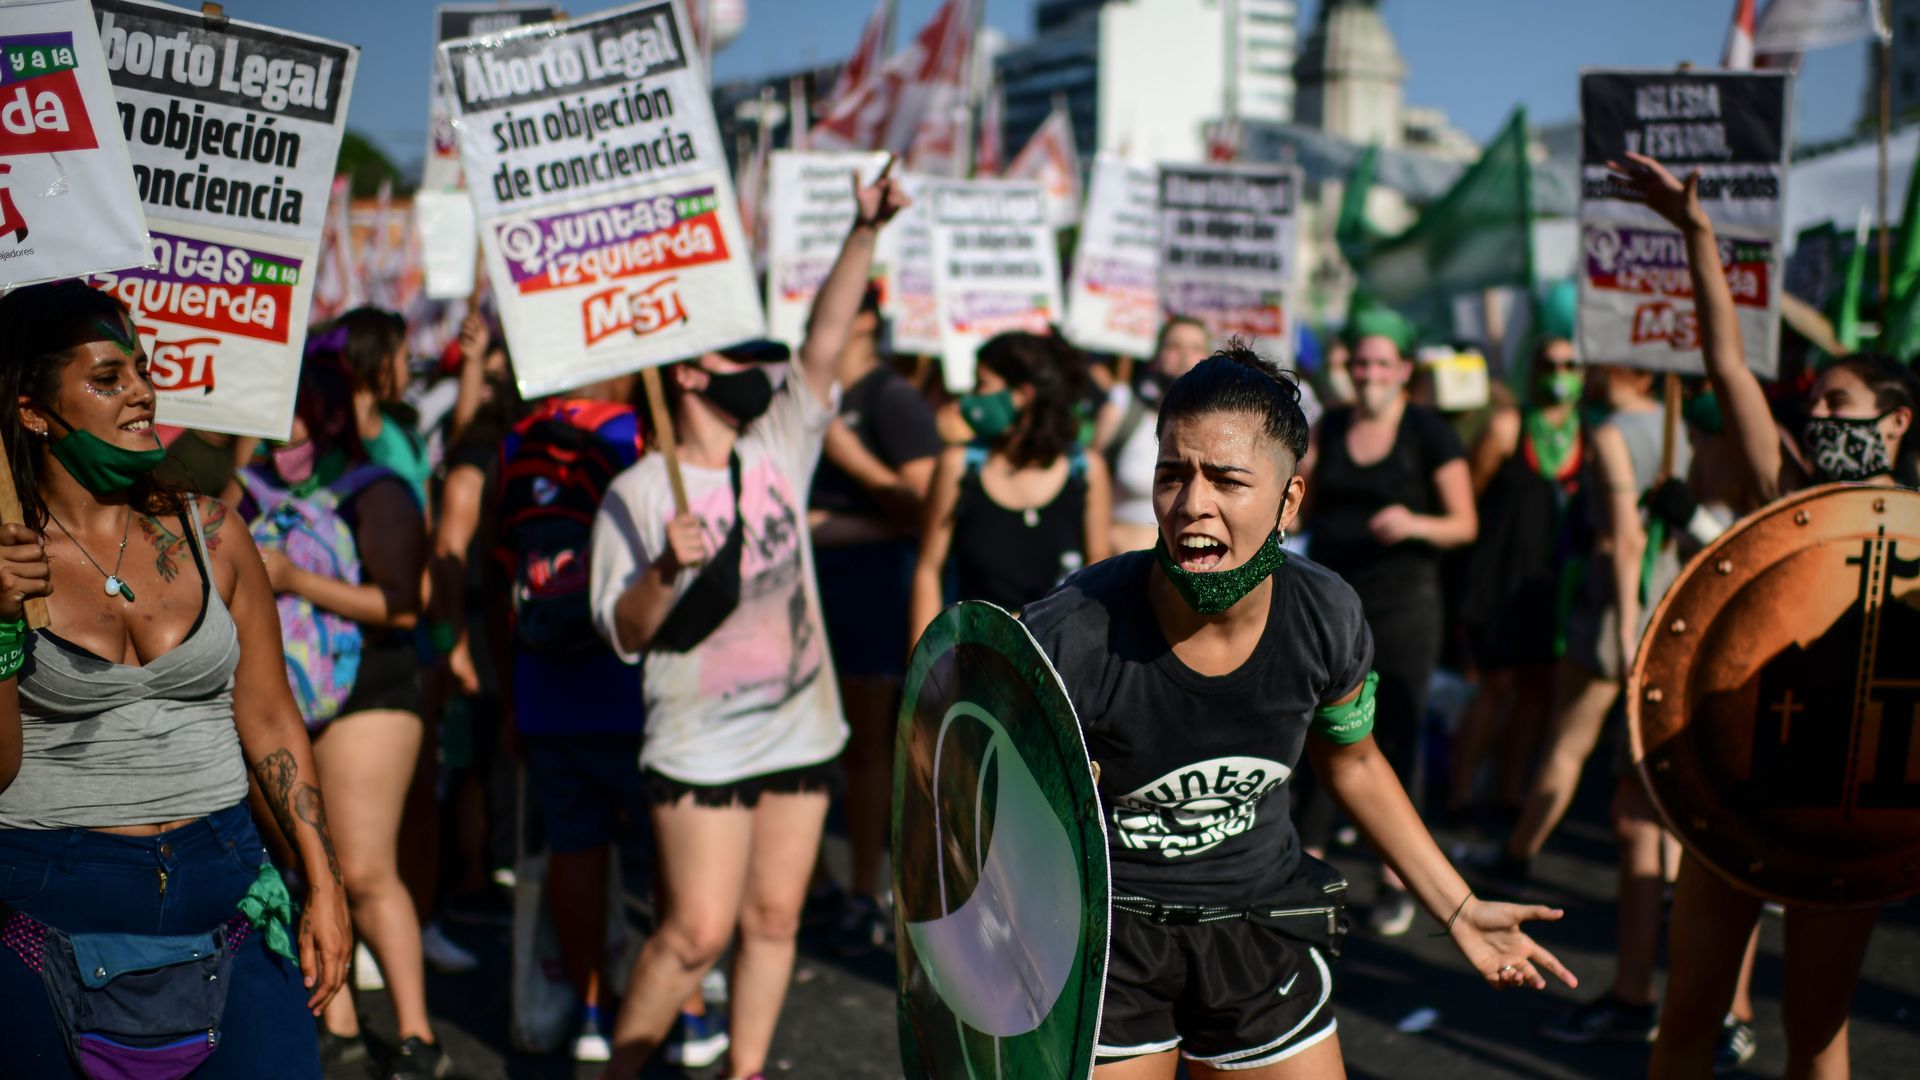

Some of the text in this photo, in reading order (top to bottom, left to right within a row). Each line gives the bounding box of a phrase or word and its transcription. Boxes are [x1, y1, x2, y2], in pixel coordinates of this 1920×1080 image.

[10, 47, 74, 72] y a la
[101, 12, 333, 112] borto Legal
[464, 16, 678, 103] Aborto Legal
[493, 111, 539, 154] sin
[546, 83, 674, 148] objeción
[1635, 85, 1720, 120] IGLESIA
[140, 99, 302, 168] objeción
[134, 164, 304, 225] onciencia
[493, 131, 697, 201] de conciencia
[0, 247, 35, 260] ajadores
[150, 236, 252, 286] ntas
[546, 222, 715, 286] izquierda
[93, 272, 277, 330] zquierda
[588, 285, 684, 336] MST
[1639, 309, 1698, 349] MS
[1128, 764, 1283, 806] untas
